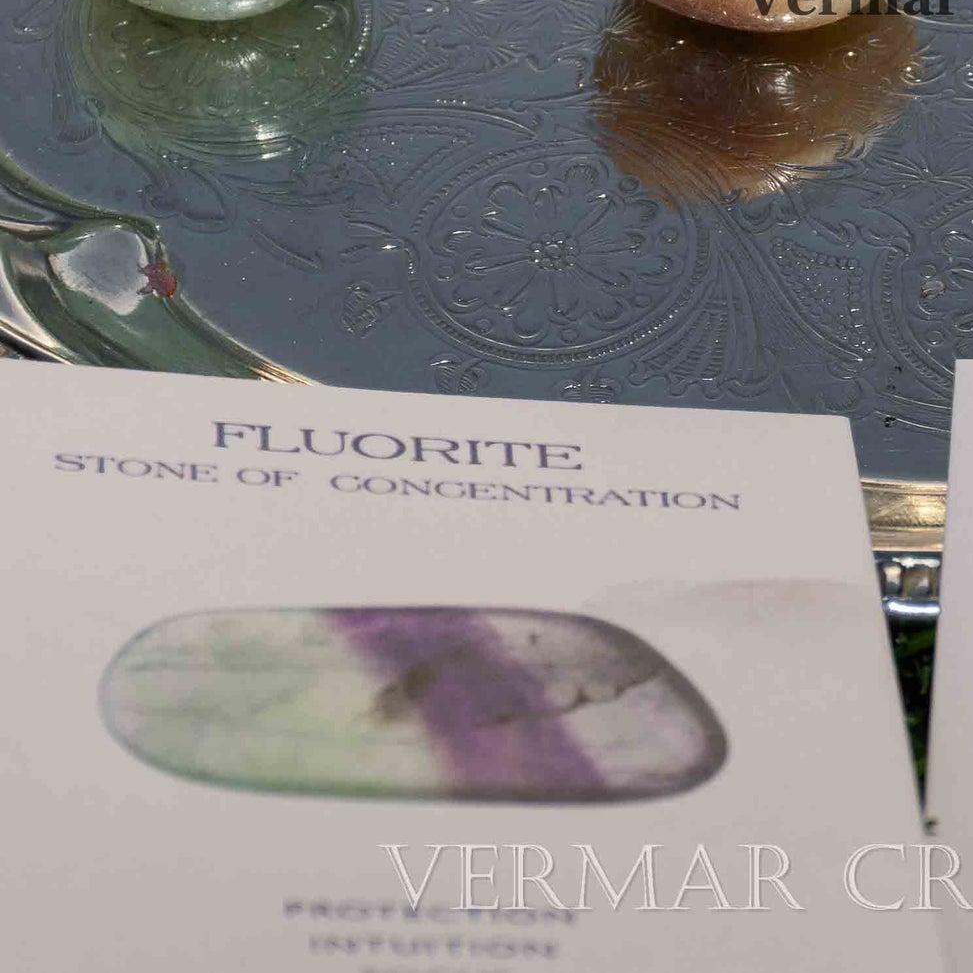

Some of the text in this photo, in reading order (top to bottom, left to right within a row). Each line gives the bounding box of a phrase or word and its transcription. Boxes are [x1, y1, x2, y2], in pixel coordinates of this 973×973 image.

[211, 420, 583, 471] FLUORITE
[54, 452, 740, 511] STONE OF CONCENTRATION
